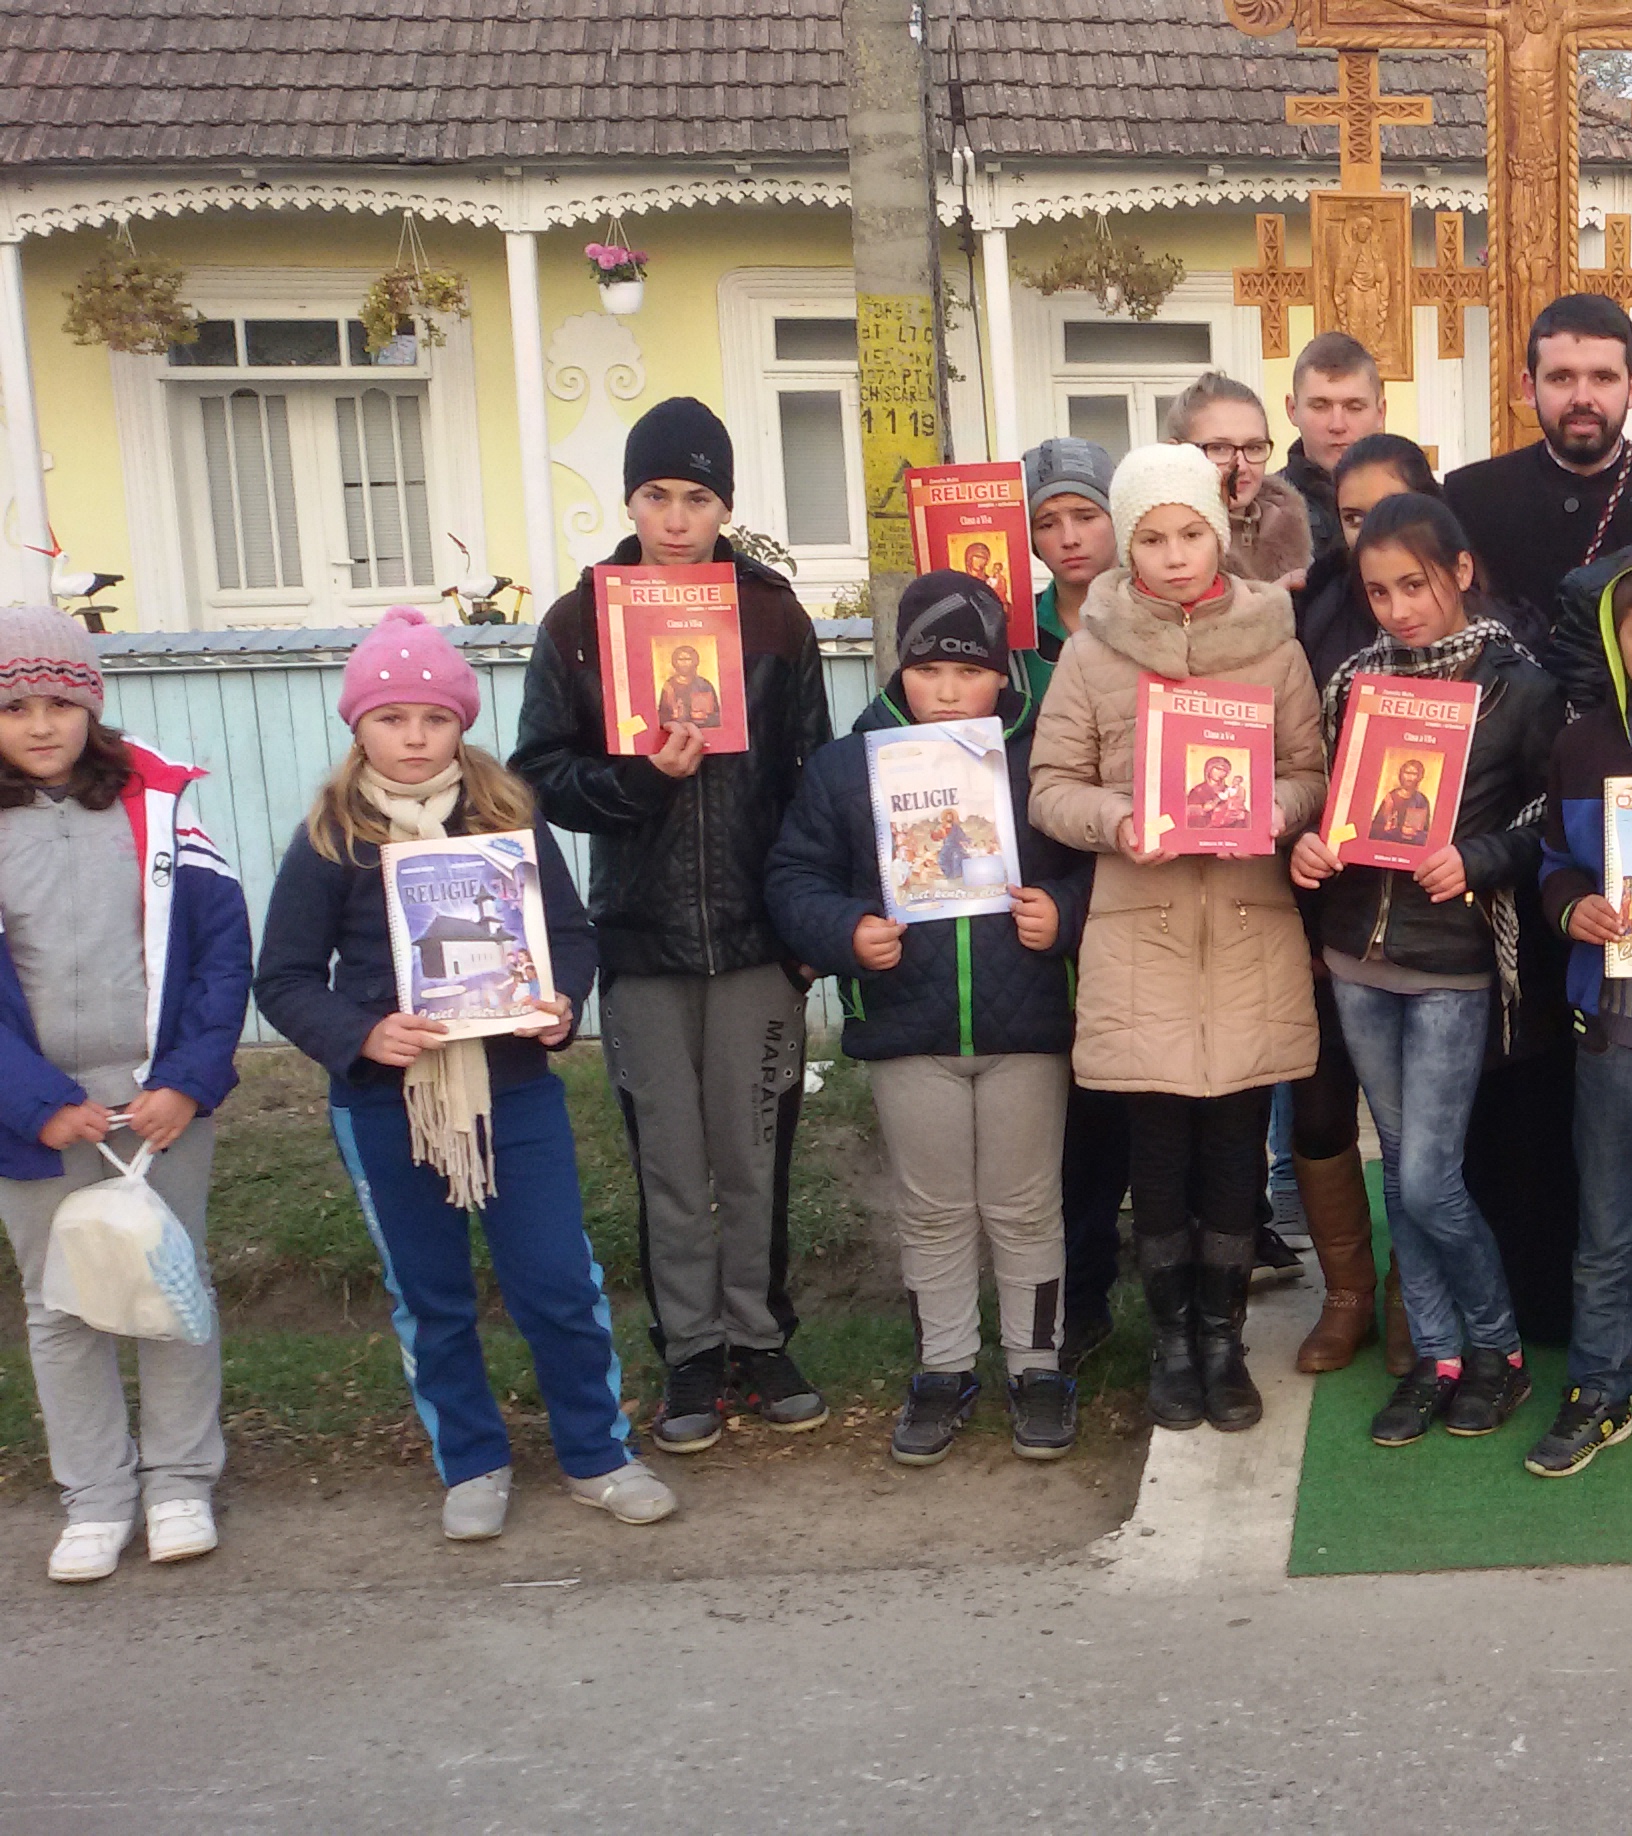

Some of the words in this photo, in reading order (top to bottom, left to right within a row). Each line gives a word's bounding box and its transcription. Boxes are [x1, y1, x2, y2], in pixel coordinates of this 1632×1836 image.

[931, 484, 1009, 502] RELIGIE
[632, 587, 720, 603] RELIGIE
[1173, 697, 1257, 719] RELIGIE
[1380, 699, 1459, 720] RELIGIE
[891, 788, 959, 813] RELIGIE
[404, 879, 479, 904] RELIGIE
